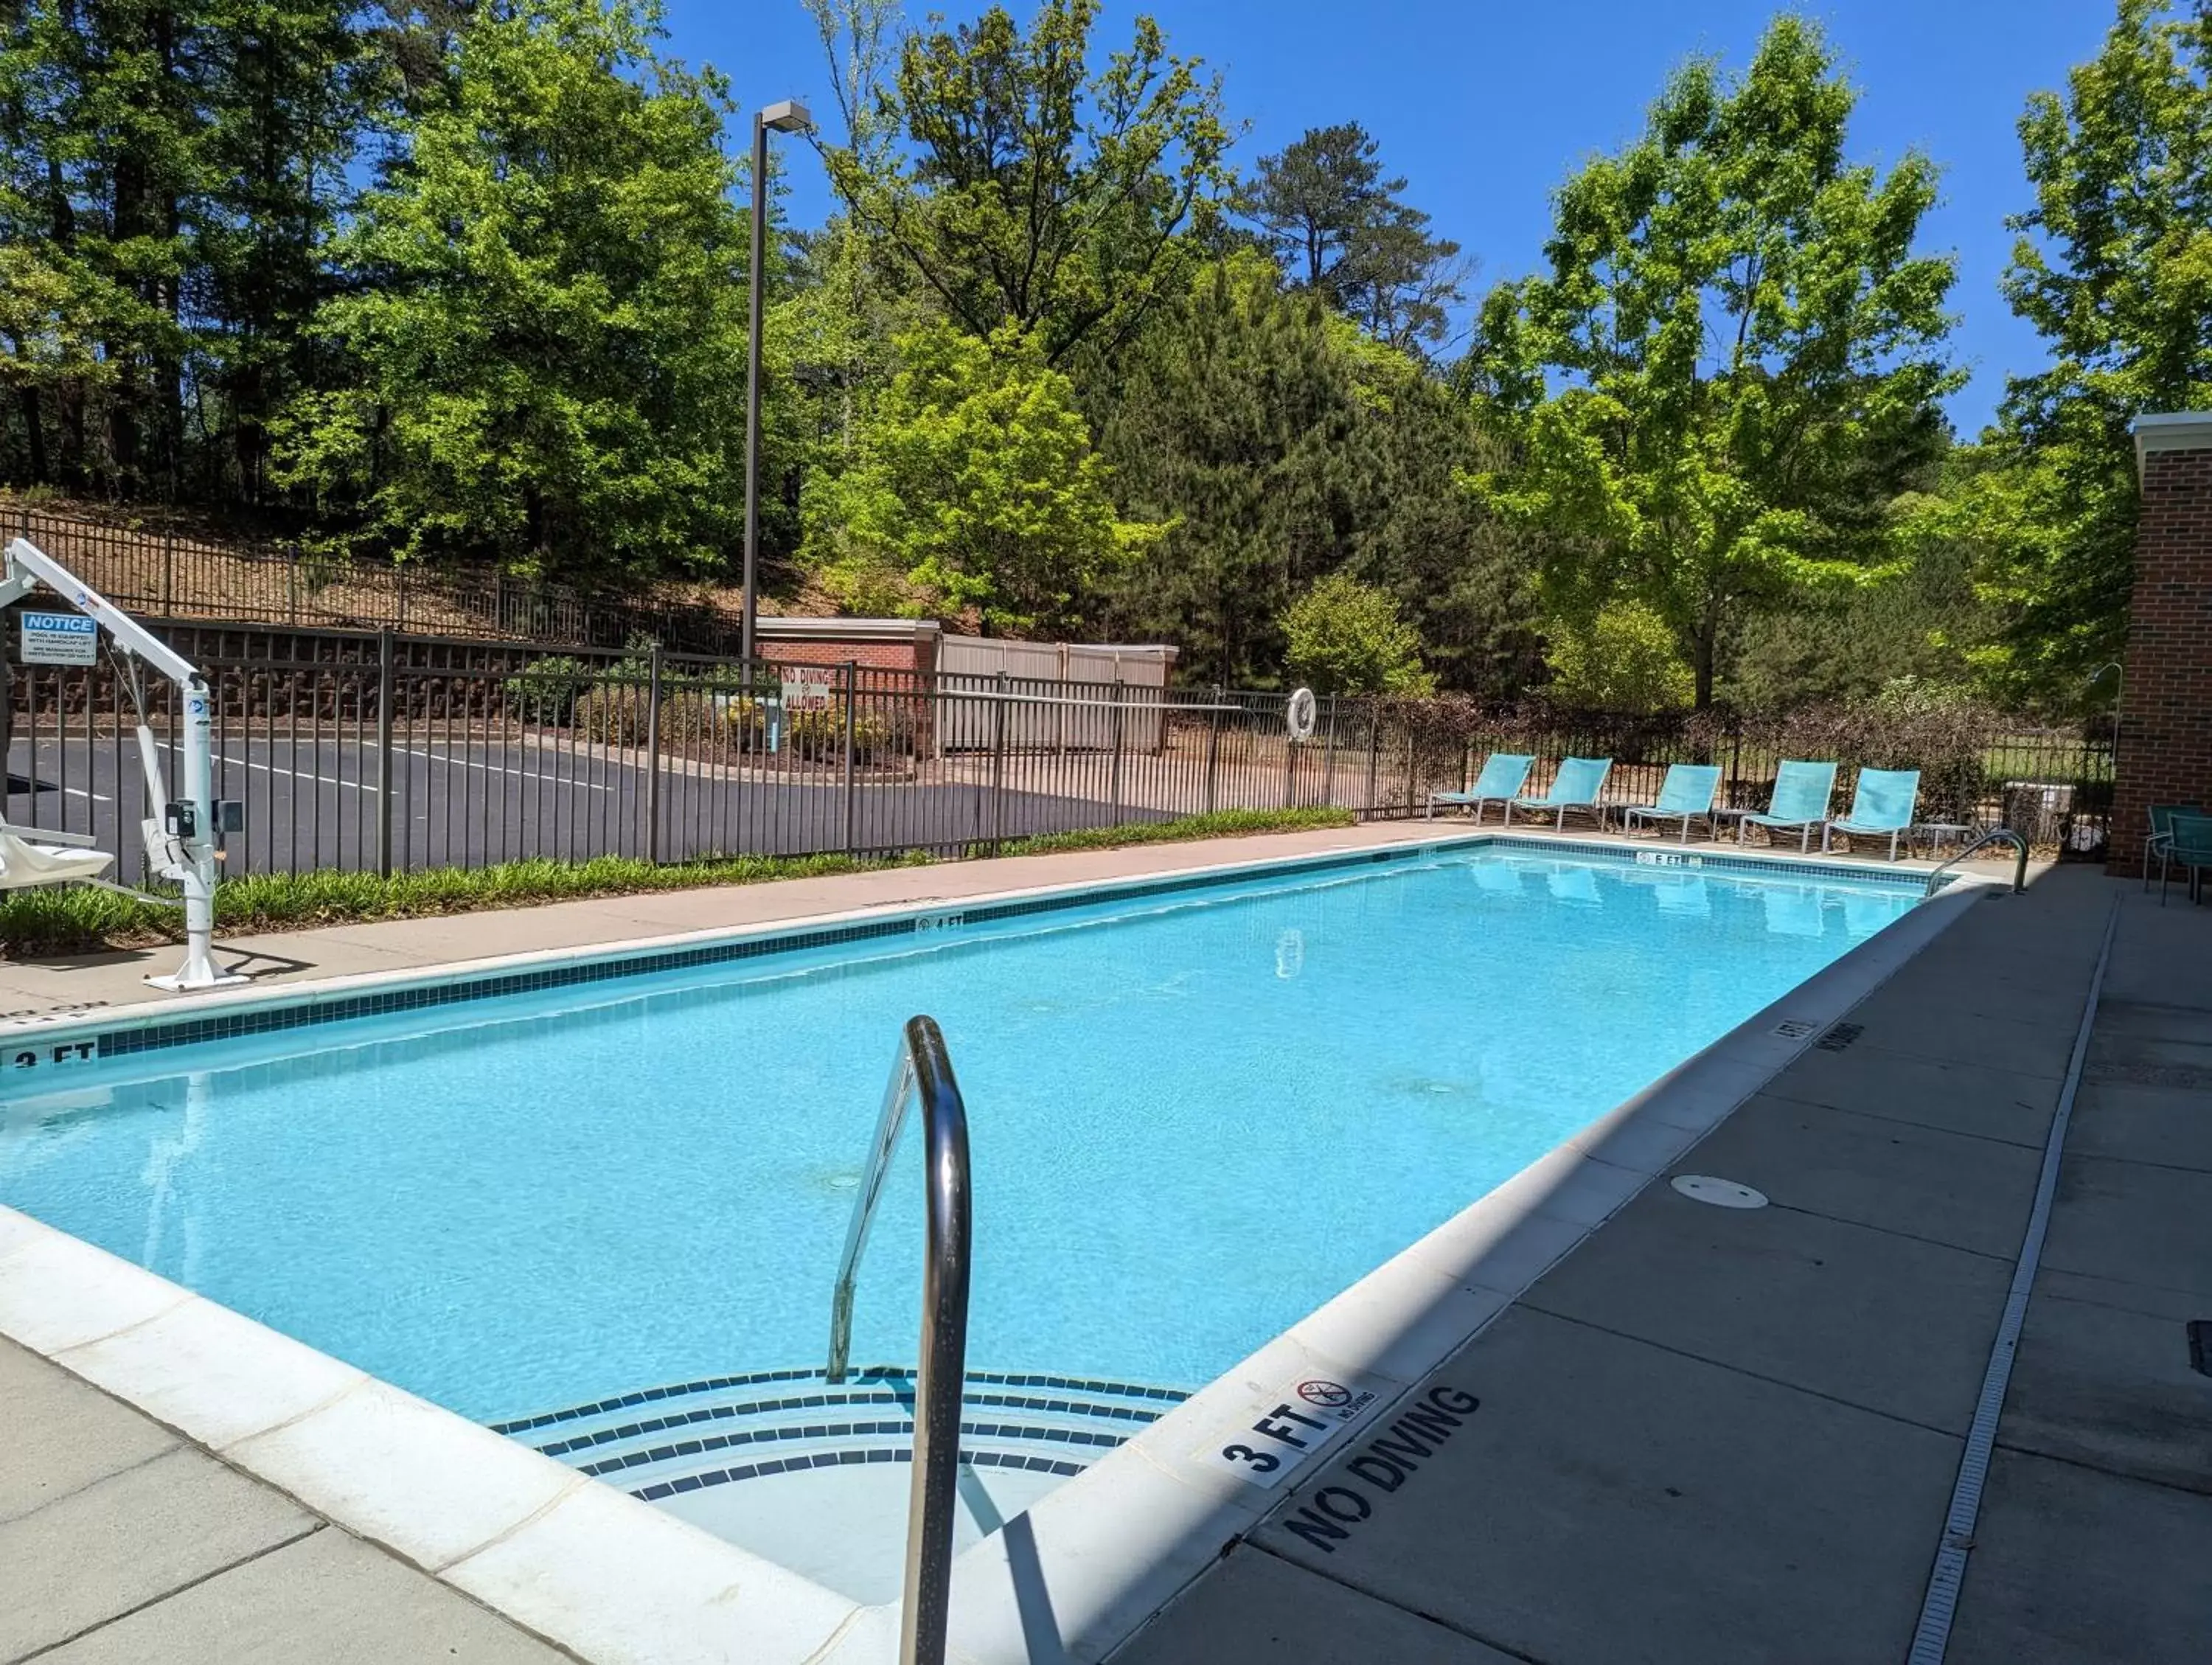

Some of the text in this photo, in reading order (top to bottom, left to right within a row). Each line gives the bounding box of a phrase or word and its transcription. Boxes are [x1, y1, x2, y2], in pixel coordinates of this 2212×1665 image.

[27, 615, 93, 631] NOTICE
[783, 667, 827, 685] NO DIVING
[786, 695, 825, 710] ALLOWED
[948, 915, 962, 927] FT
[54, 1042, 95, 1063] FT
[1222, 1403, 1329, 1473] 3 FT
[1283, 1386, 1481, 1554] NO DIVING
